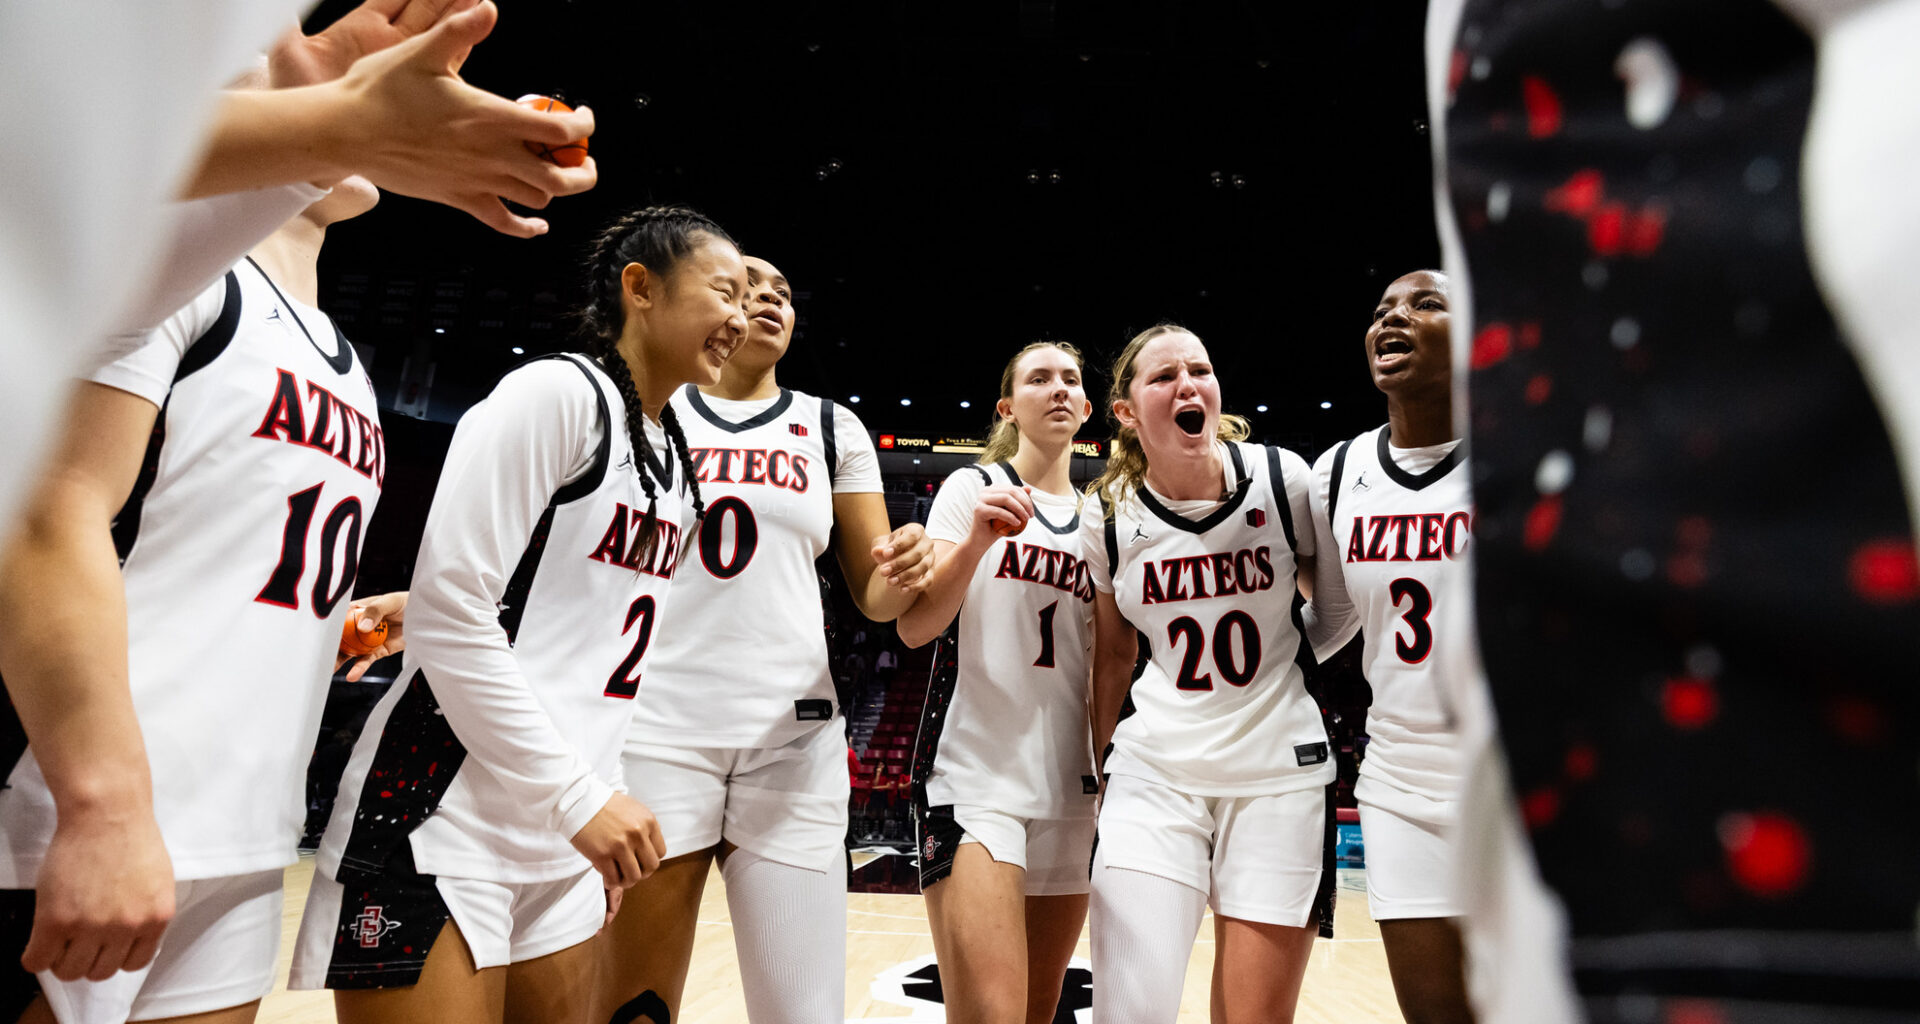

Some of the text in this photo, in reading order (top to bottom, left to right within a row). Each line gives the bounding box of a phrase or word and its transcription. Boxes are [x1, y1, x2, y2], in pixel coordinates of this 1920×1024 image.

[687, 447, 809, 494] ZTECS
[896, 438, 930, 447] TOYOTA
[253, 480, 361, 620] 10
[698, 495, 758, 580] 0
[994, 540, 1096, 603] AZTECS
[1142, 546, 1274, 604] AZTECS
[603, 594, 656, 699] 2
[1032, 599, 1055, 668] 1
[1167, 610, 1261, 691] 20
[1389, 577, 1432, 664] 3
